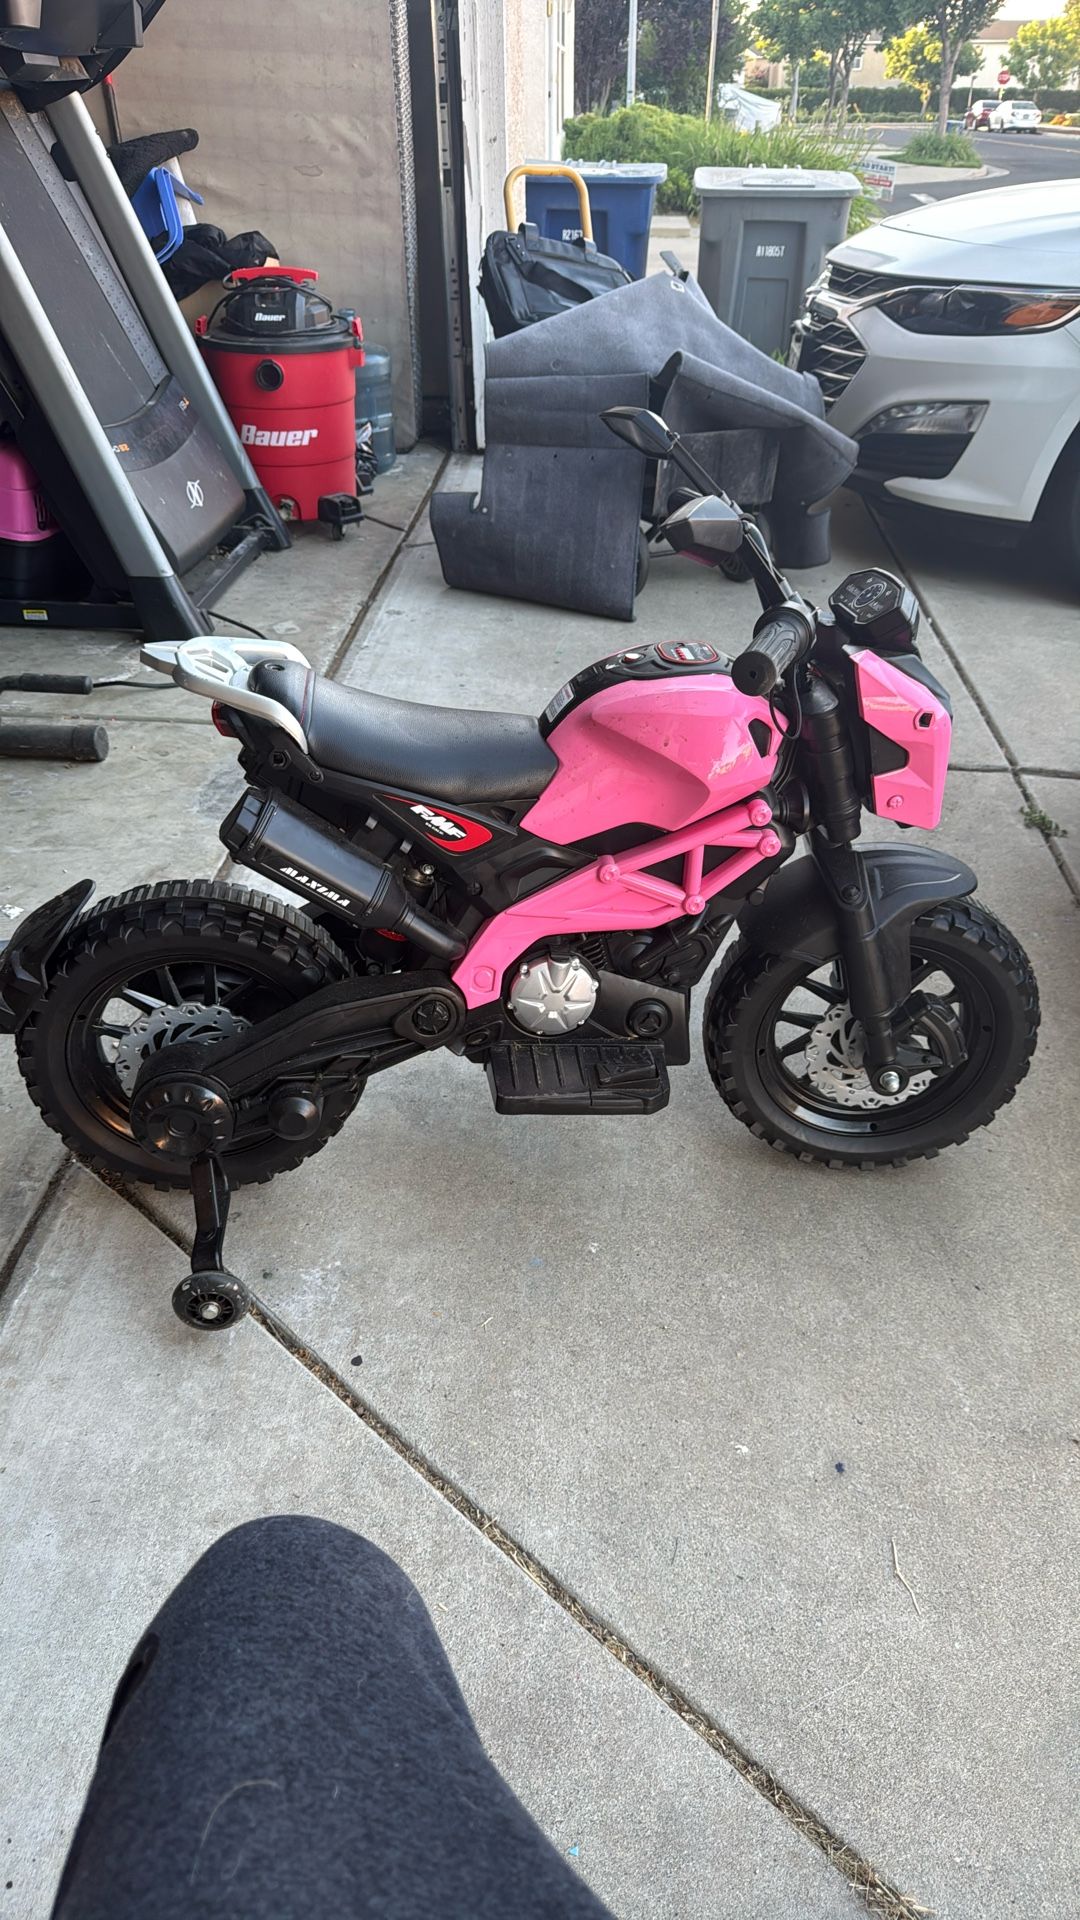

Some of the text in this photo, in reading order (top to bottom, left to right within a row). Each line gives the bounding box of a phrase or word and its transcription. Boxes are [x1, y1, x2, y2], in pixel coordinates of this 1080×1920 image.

[254, 312, 286, 322] Bauer
[241, 424, 318, 447] Bauer
[410, 804, 467, 838] FMF
[280, 867, 351, 907] MAXIMA
